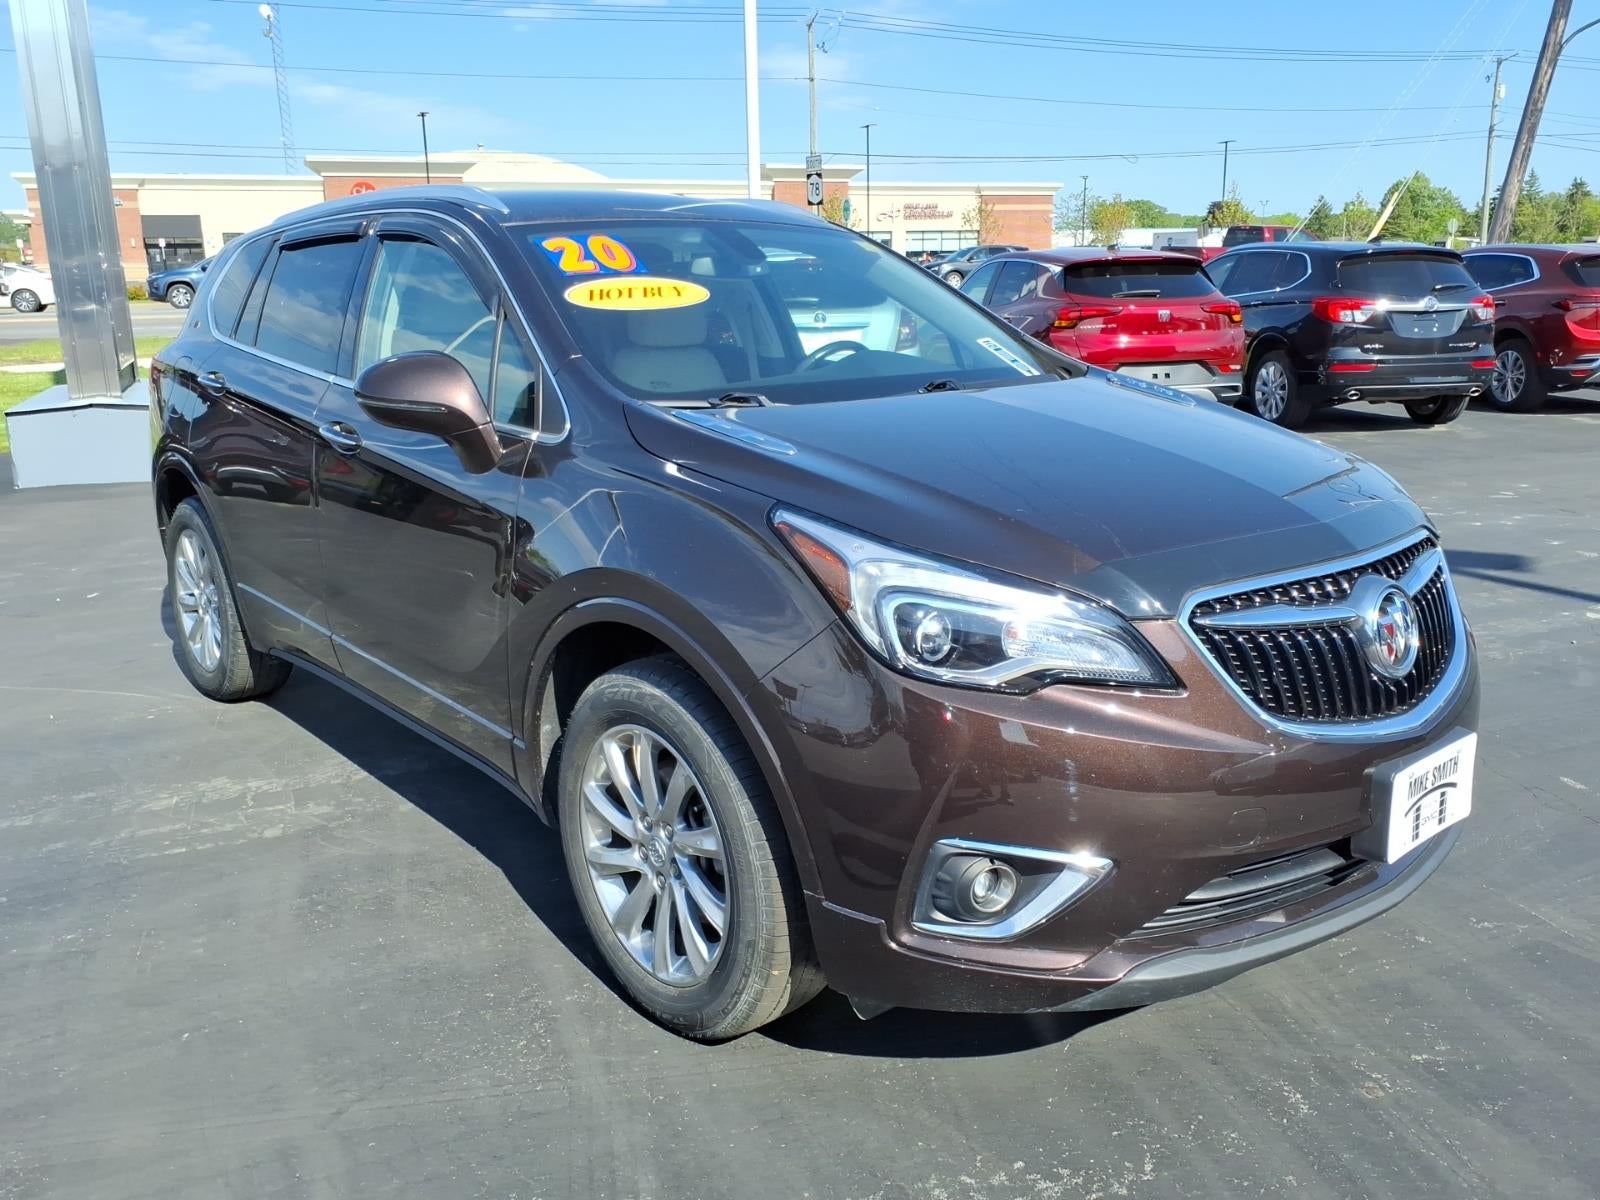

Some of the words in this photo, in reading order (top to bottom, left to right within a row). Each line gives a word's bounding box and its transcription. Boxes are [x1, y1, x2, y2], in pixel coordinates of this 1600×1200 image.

[810, 183, 820, 197] 78
[541, 234, 636, 273] 20
[589, 287, 637, 301] HOT
[643, 286, 685, 299] BUY
[1408, 770, 1430, 801] MIKE
[1431, 754, 1459, 787] SMITH
